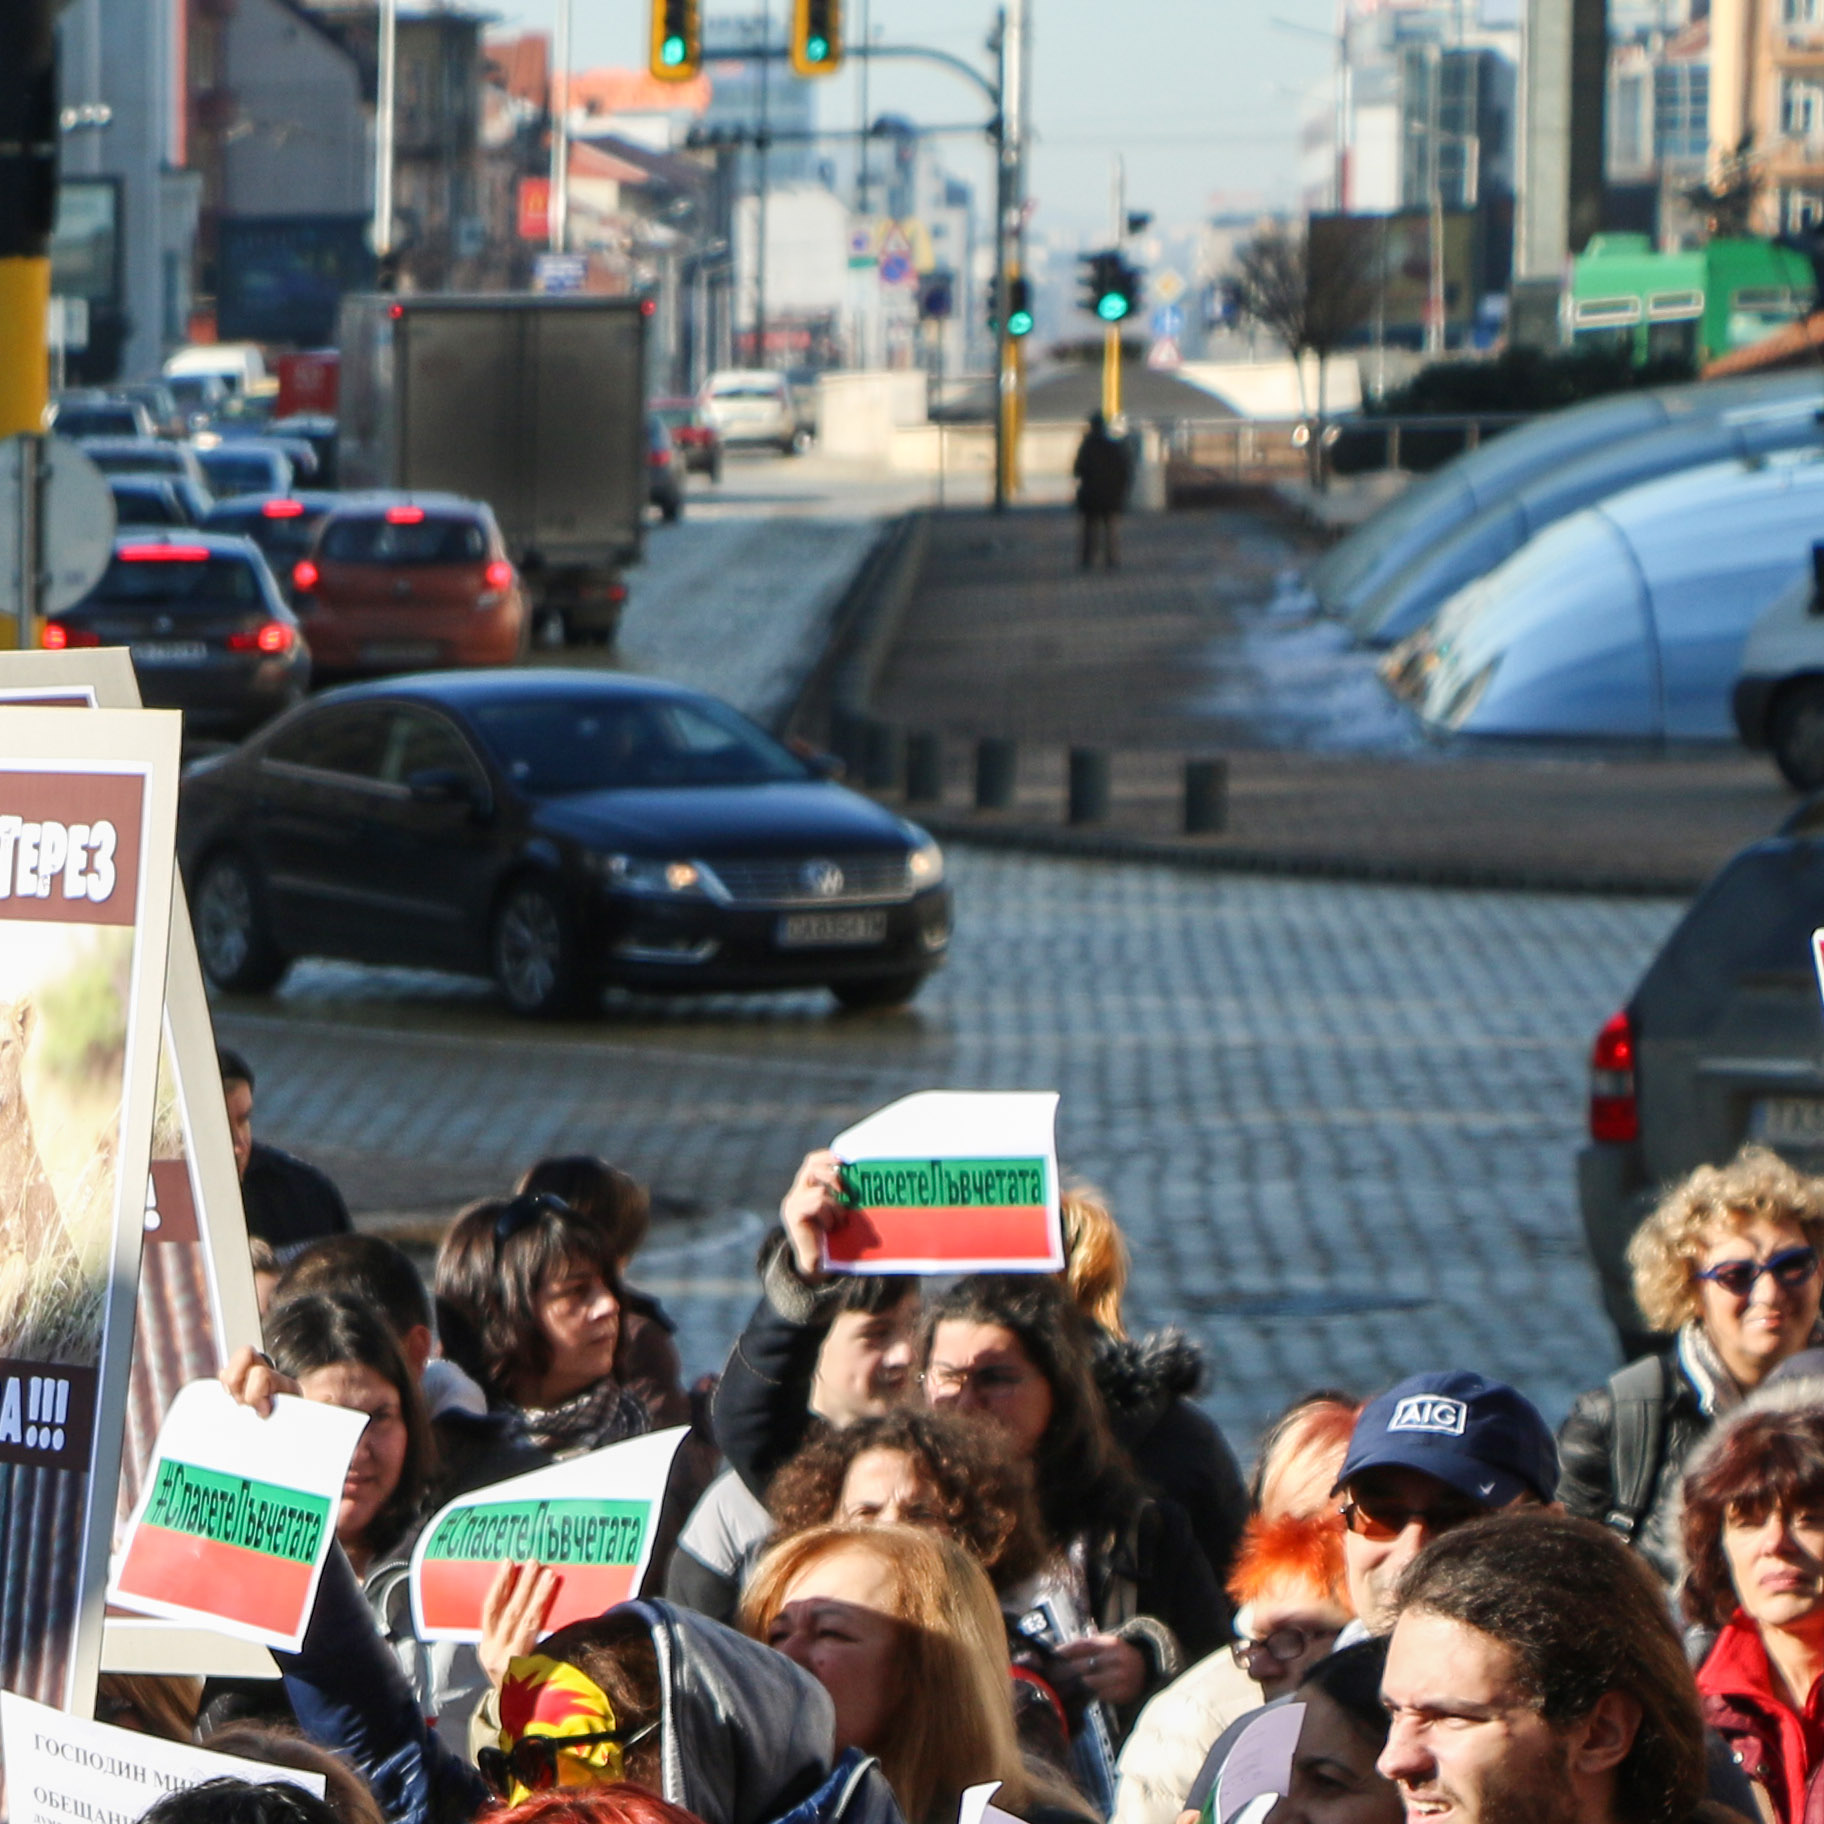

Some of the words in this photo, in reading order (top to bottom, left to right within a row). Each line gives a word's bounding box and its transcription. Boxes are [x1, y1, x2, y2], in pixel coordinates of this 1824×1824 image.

[1401, 1402, 1457, 1426] AIG
[149, 1462, 324, 1567] #СпасетеЛъвчетата
[436, 1500, 643, 1565] #СпасетеЛъвчетата
[34, 1733, 147, 1784] ГОСПОДИН
